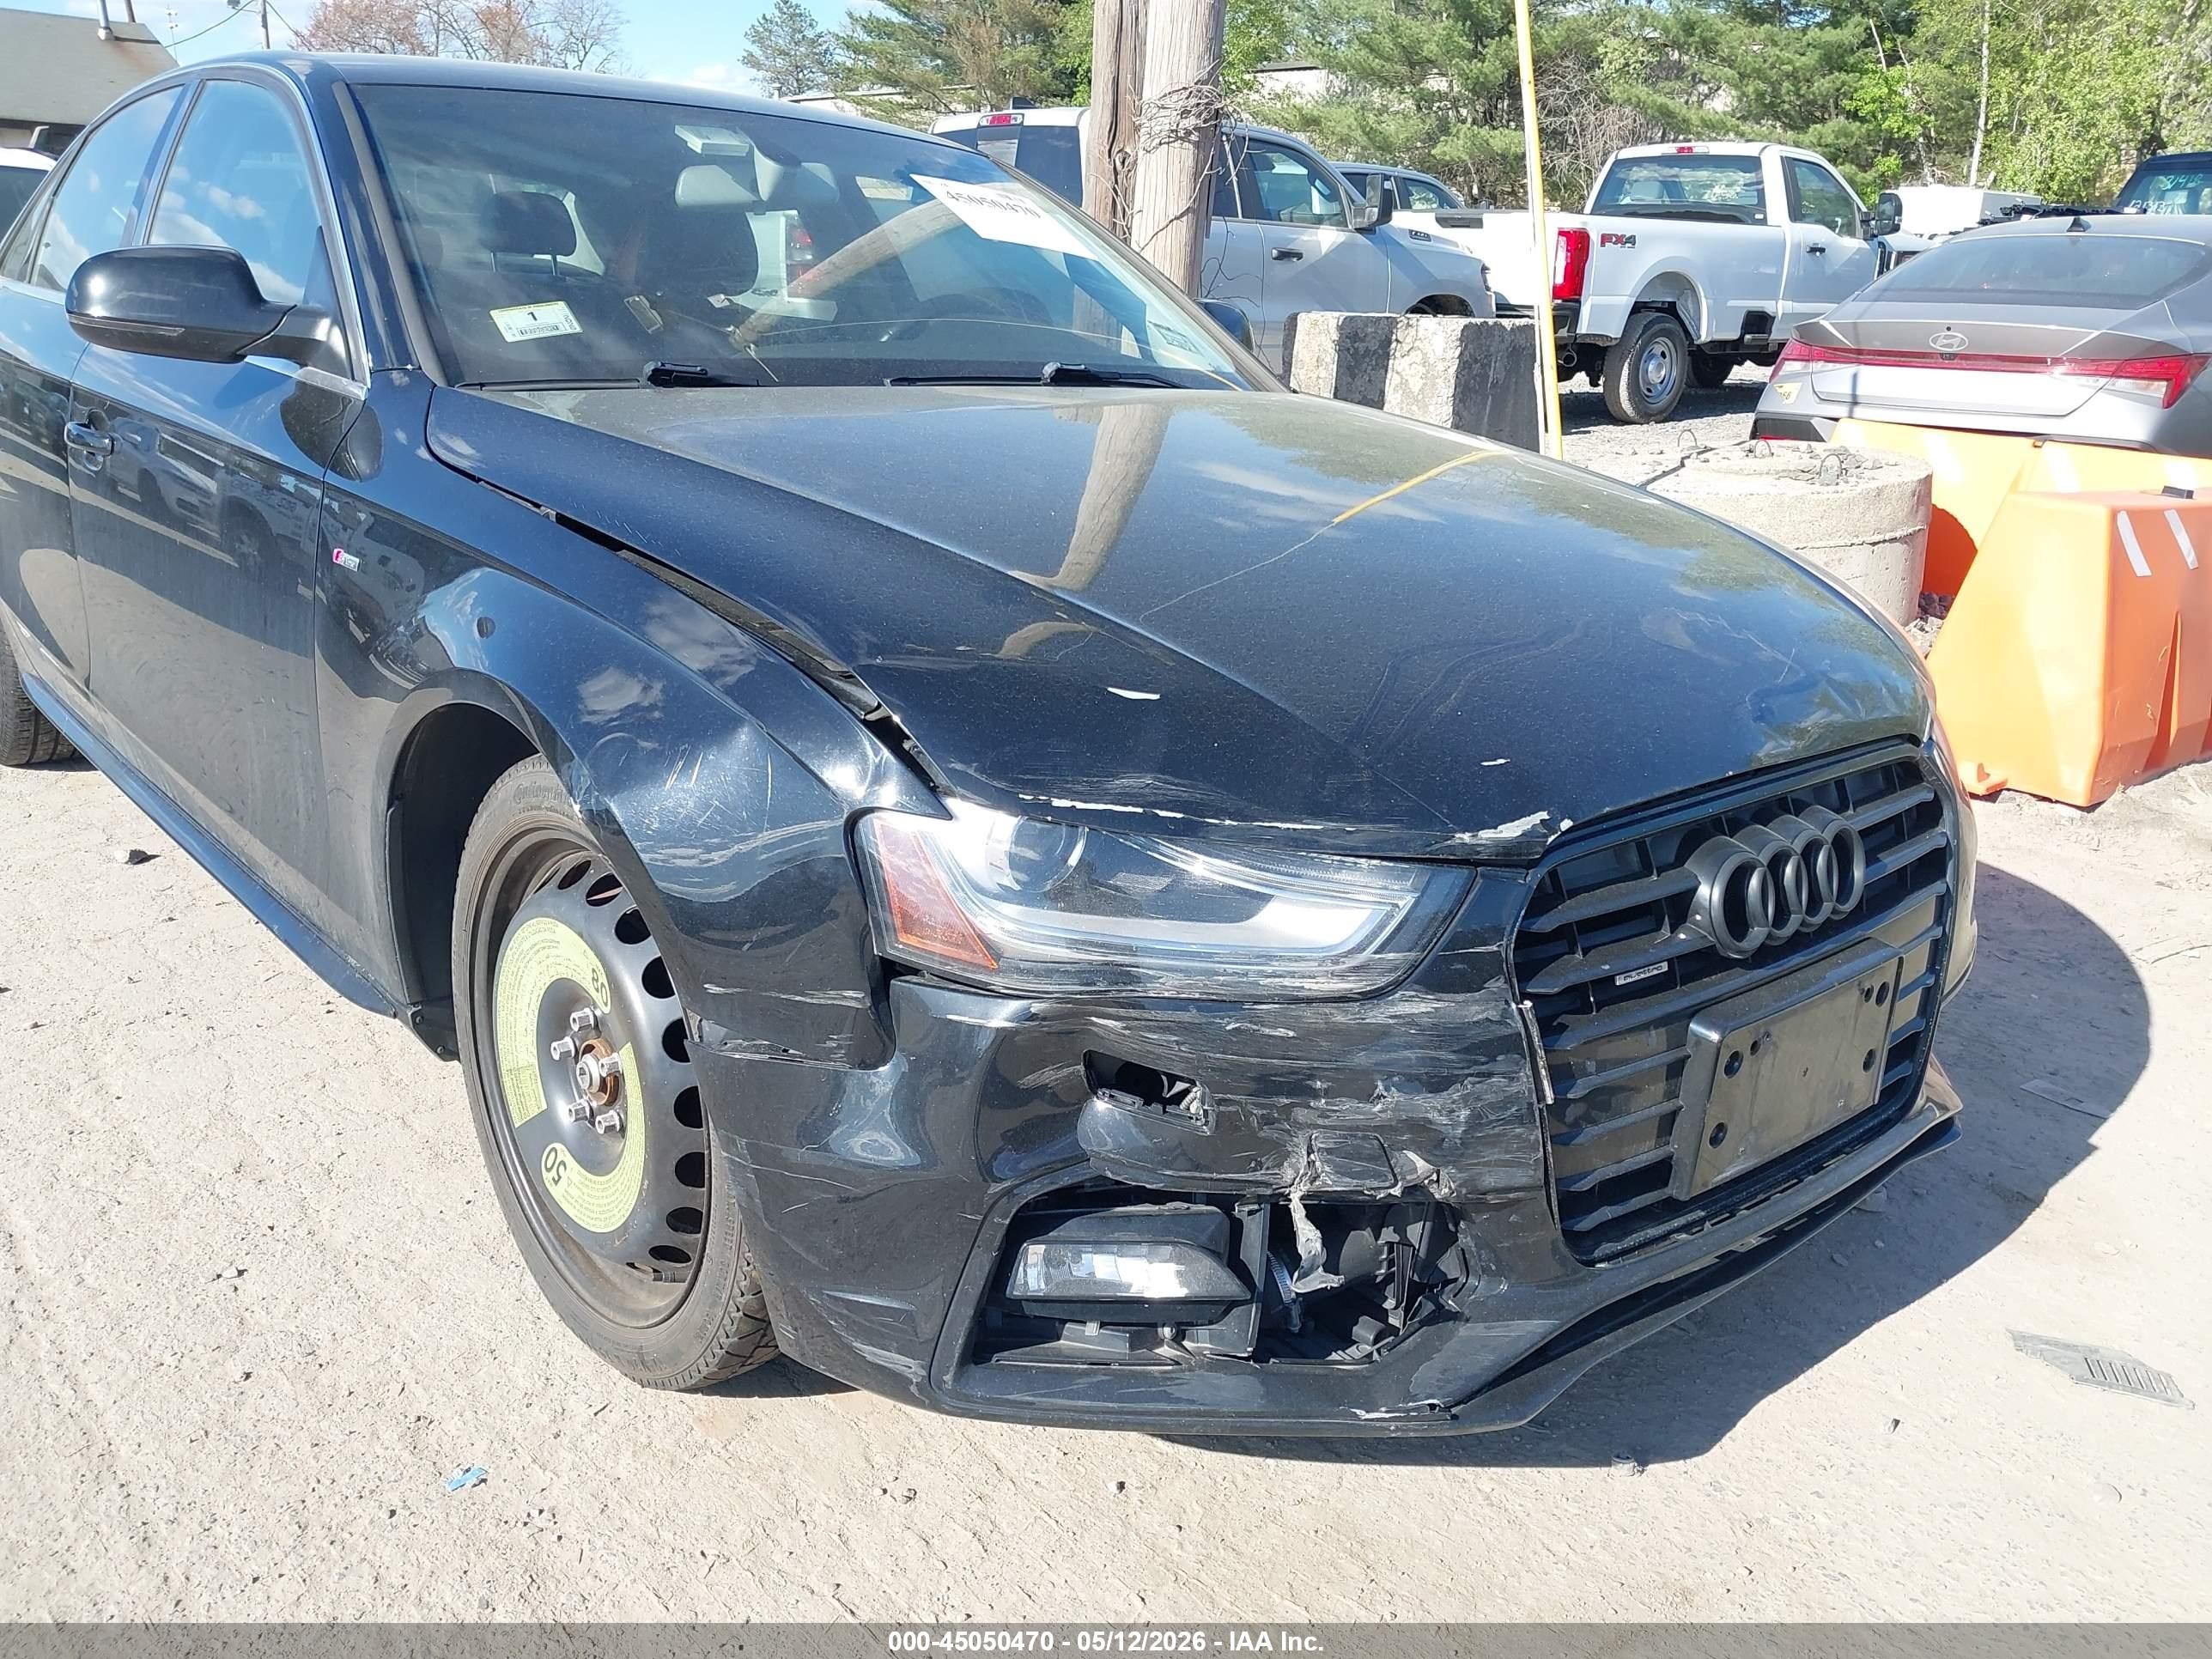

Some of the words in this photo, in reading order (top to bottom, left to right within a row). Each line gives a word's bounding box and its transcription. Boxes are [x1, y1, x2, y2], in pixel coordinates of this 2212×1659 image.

[1600, 233, 1637, 248] FX4
[1622, 963, 1664, 981] quattro
[591, 967, 609, 1007] 80
[544, 1146, 567, 1187] 50
